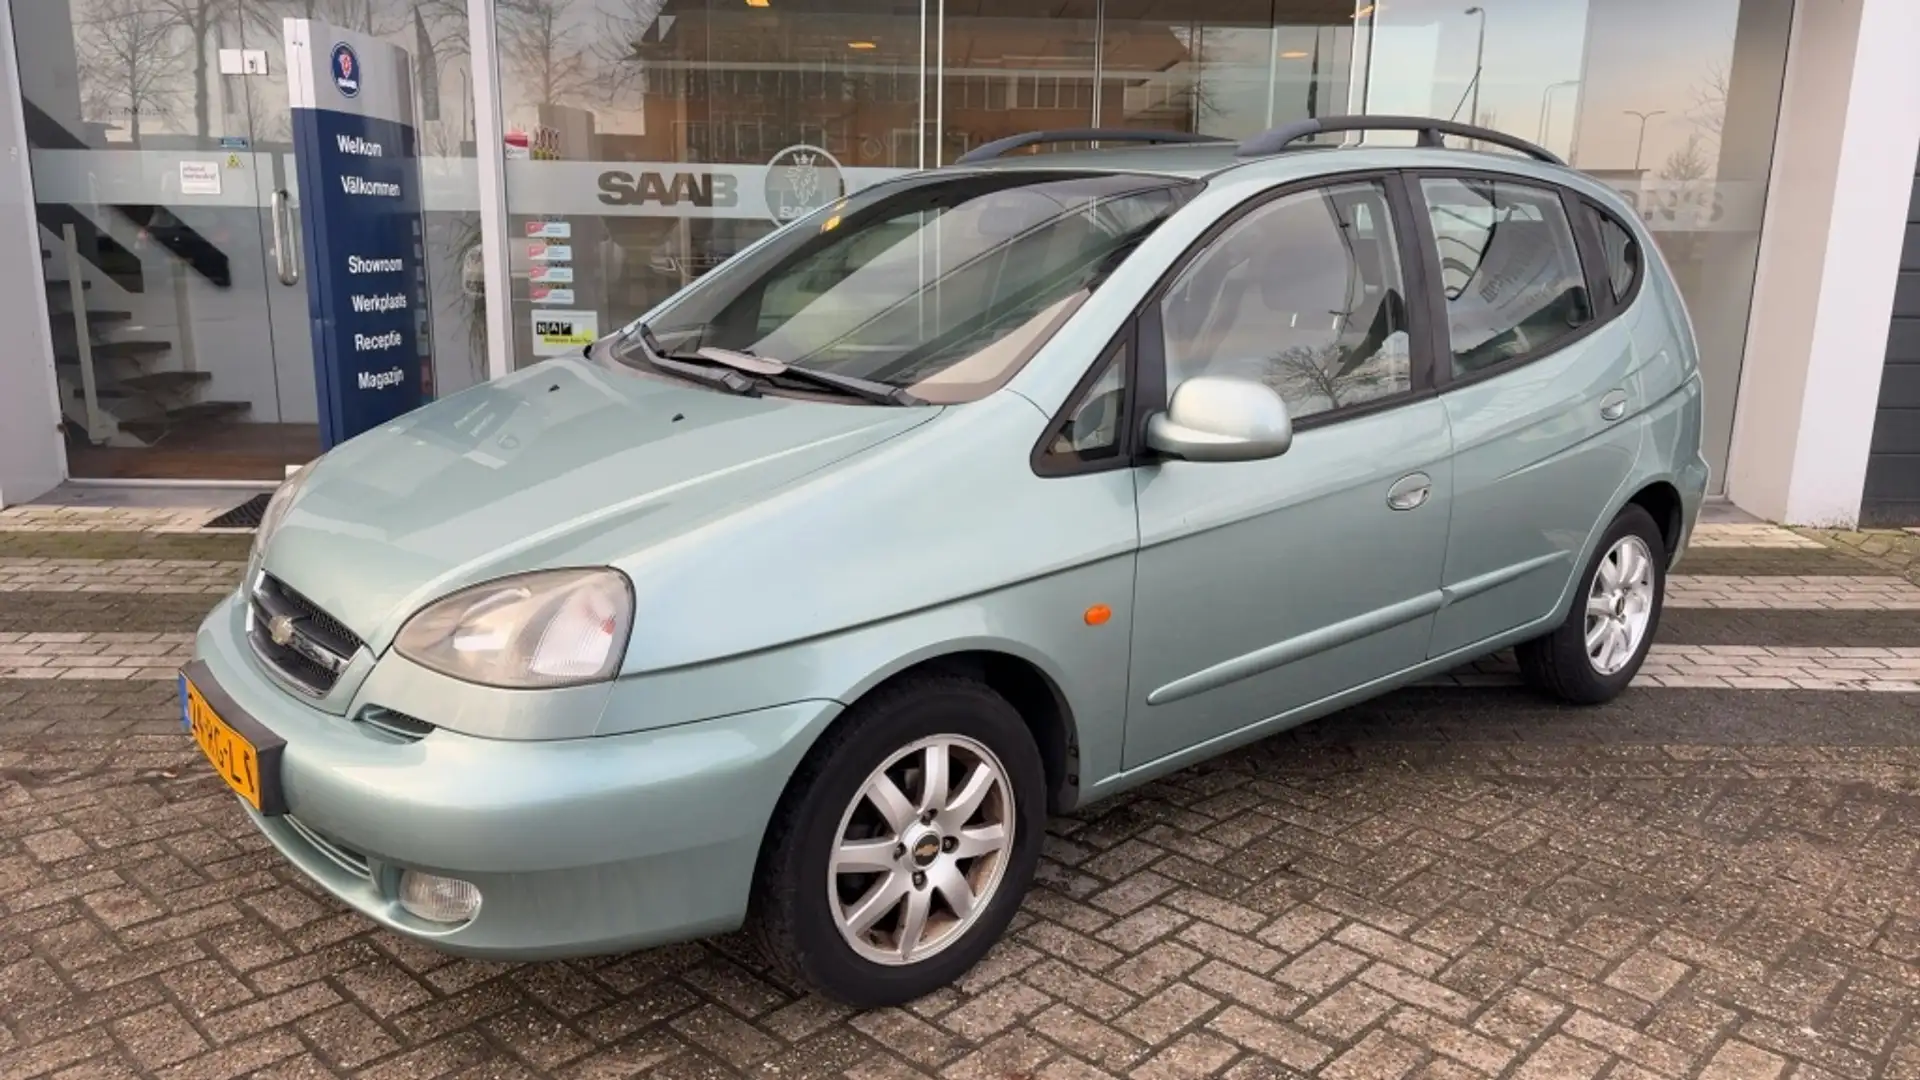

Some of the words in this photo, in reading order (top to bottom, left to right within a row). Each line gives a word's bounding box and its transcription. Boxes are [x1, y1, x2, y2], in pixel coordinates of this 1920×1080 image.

[336, 133, 383, 157] Welkom
[340, 174, 402, 197] Välkommen
[596, 170, 739, 208] SAAB
[347, 254, 404, 274] Showroom
[350, 291, 408, 314] Werkplaats
[353, 330, 403, 352] Receptie
[357, 365, 405, 390] Magazijn
